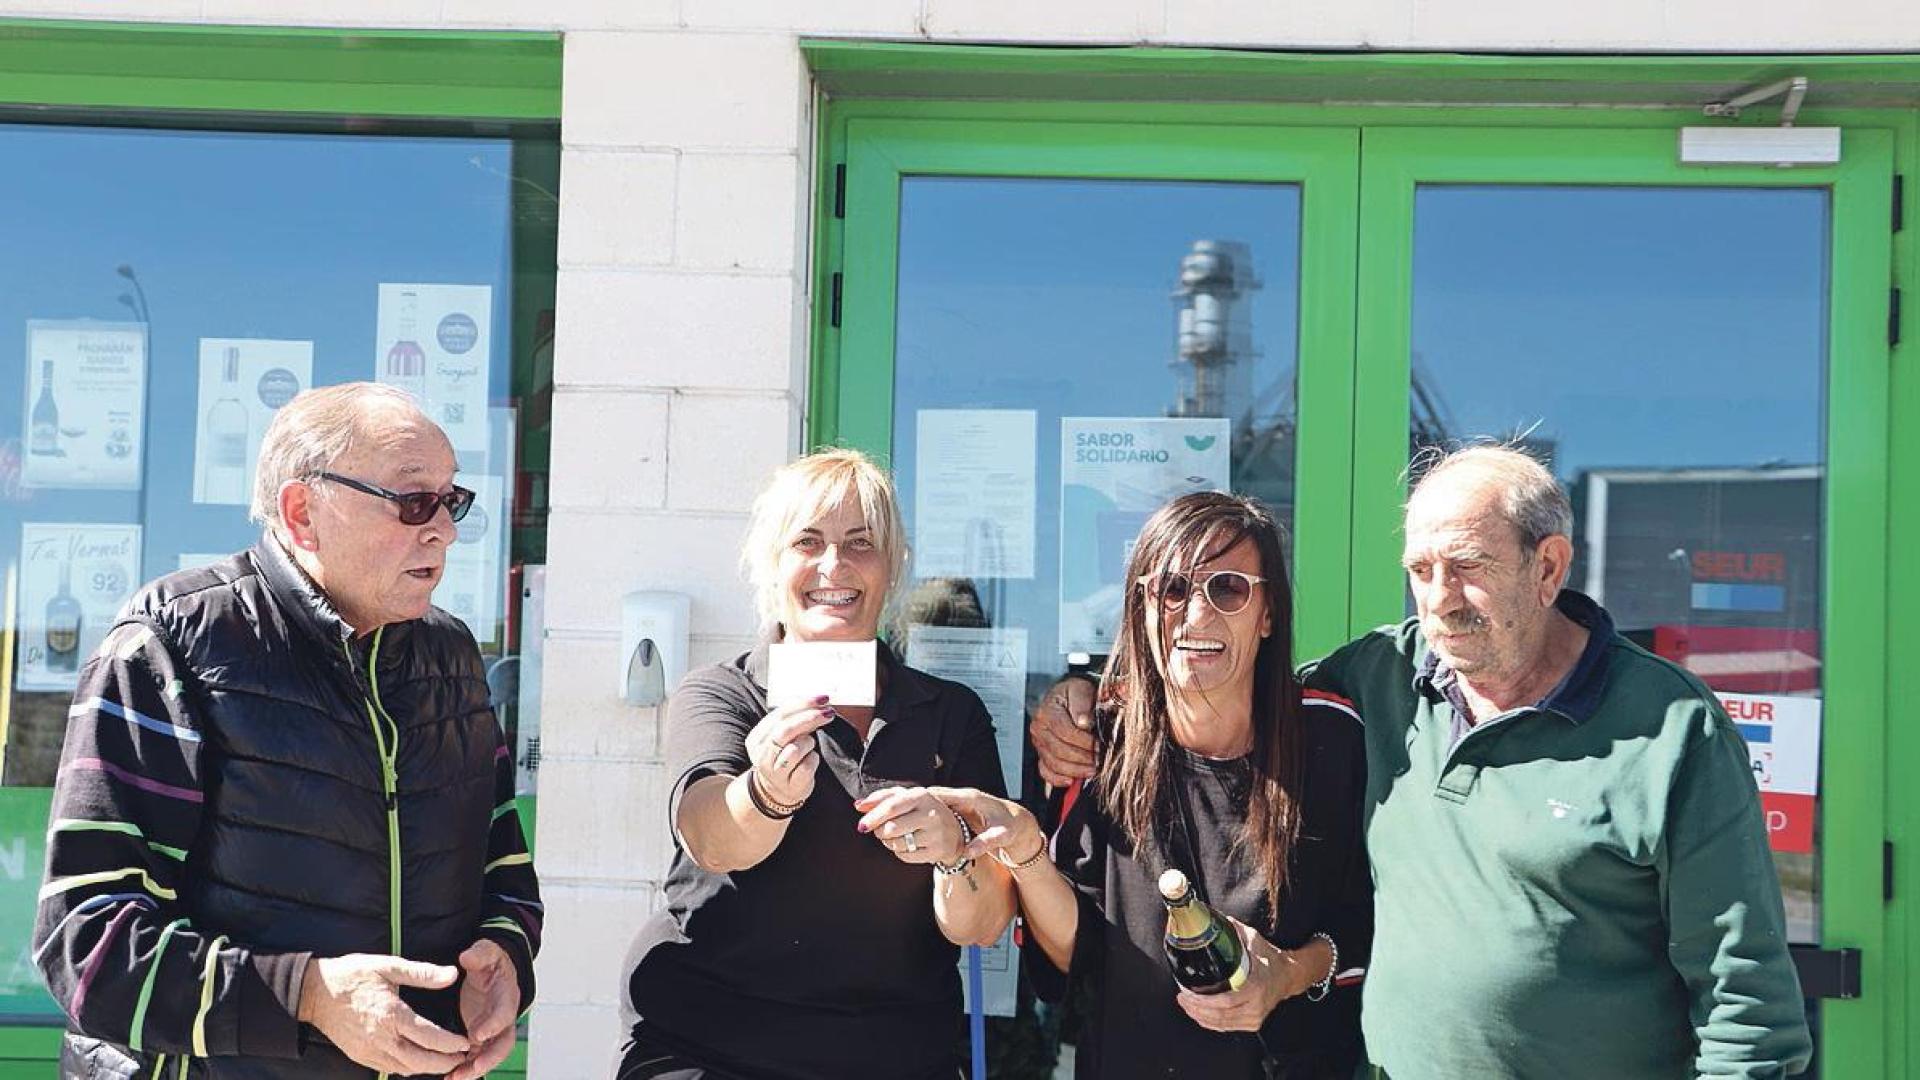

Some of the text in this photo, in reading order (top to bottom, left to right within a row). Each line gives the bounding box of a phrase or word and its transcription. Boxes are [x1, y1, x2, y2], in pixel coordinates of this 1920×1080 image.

[1075, 433, 1134, 447] SABOR
[1075, 450, 1169, 463] SOLIDARIO
[1692, 551, 1784, 578] SEUR
[92, 572, 119, 592] 92
[1722, 700, 1774, 721] EUR
